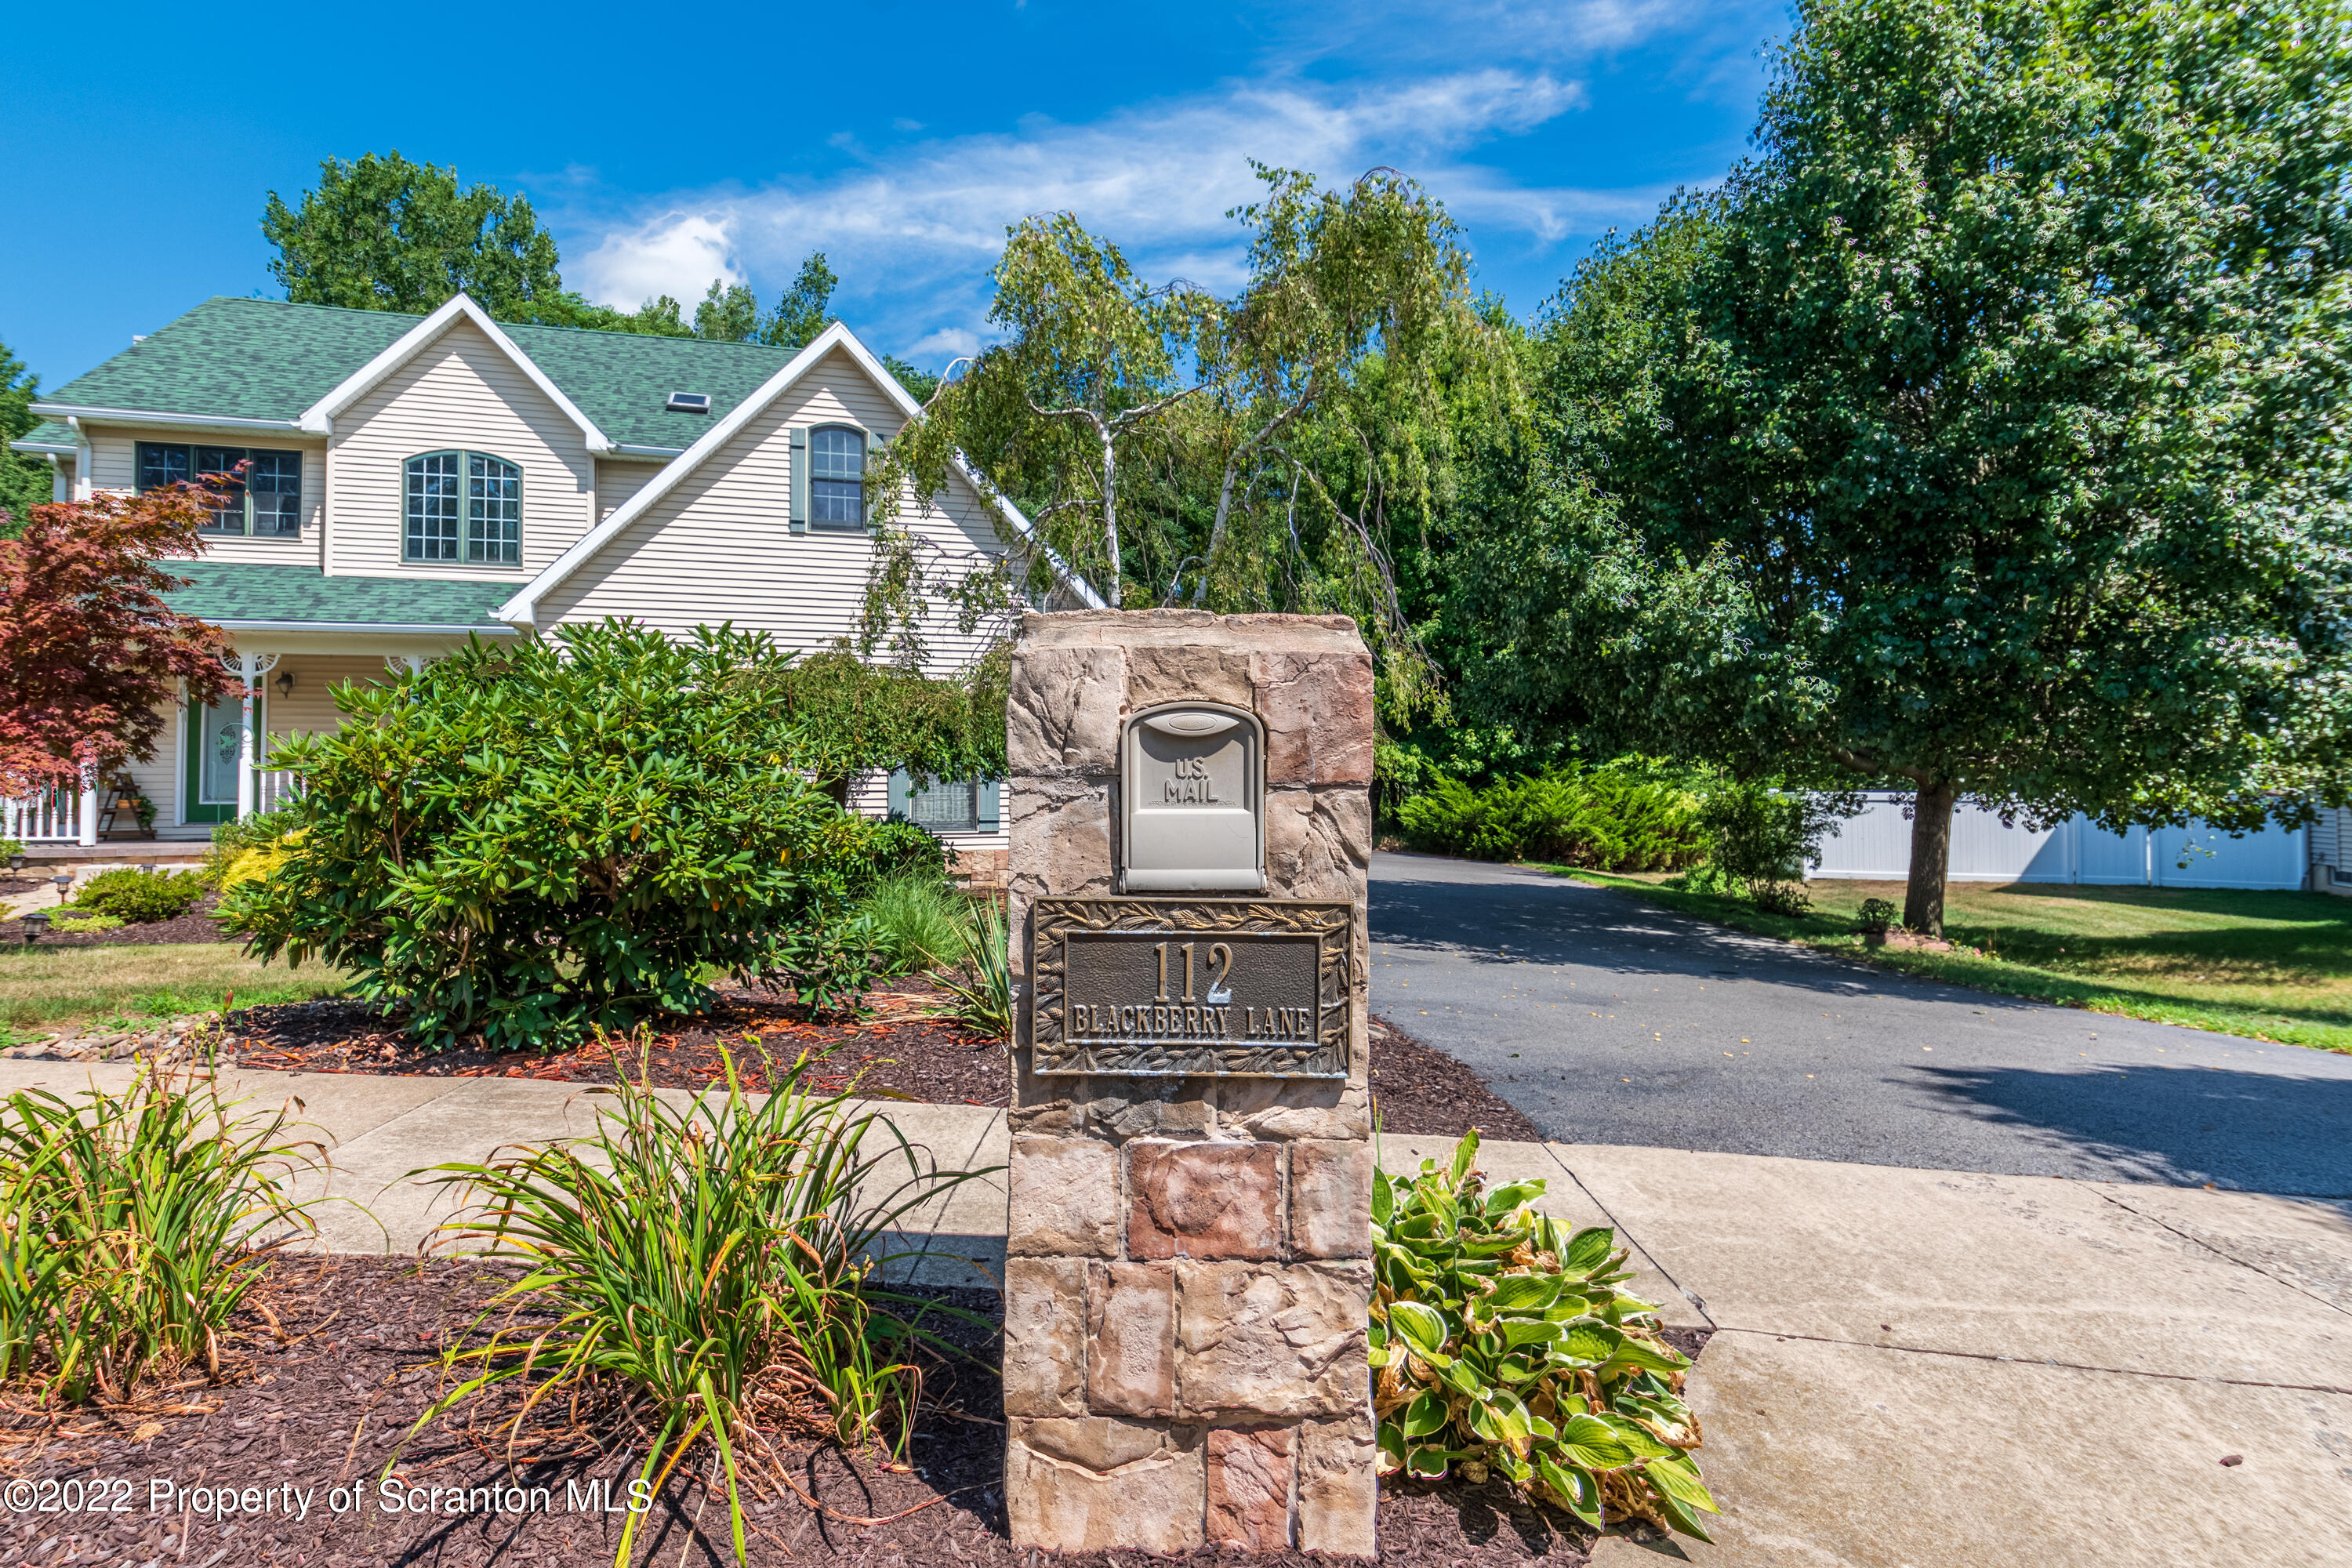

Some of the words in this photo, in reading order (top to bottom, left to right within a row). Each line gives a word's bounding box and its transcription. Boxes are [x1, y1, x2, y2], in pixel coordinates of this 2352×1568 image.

[1175, 757, 1209, 780] U.S.
[1164, 779, 1219, 803] MAIL
[1154, 942, 1233, 1004] 112
[1073, 1004, 1230, 1035] BLACKBERRY
[1246, 1006, 1311, 1036] LANE
